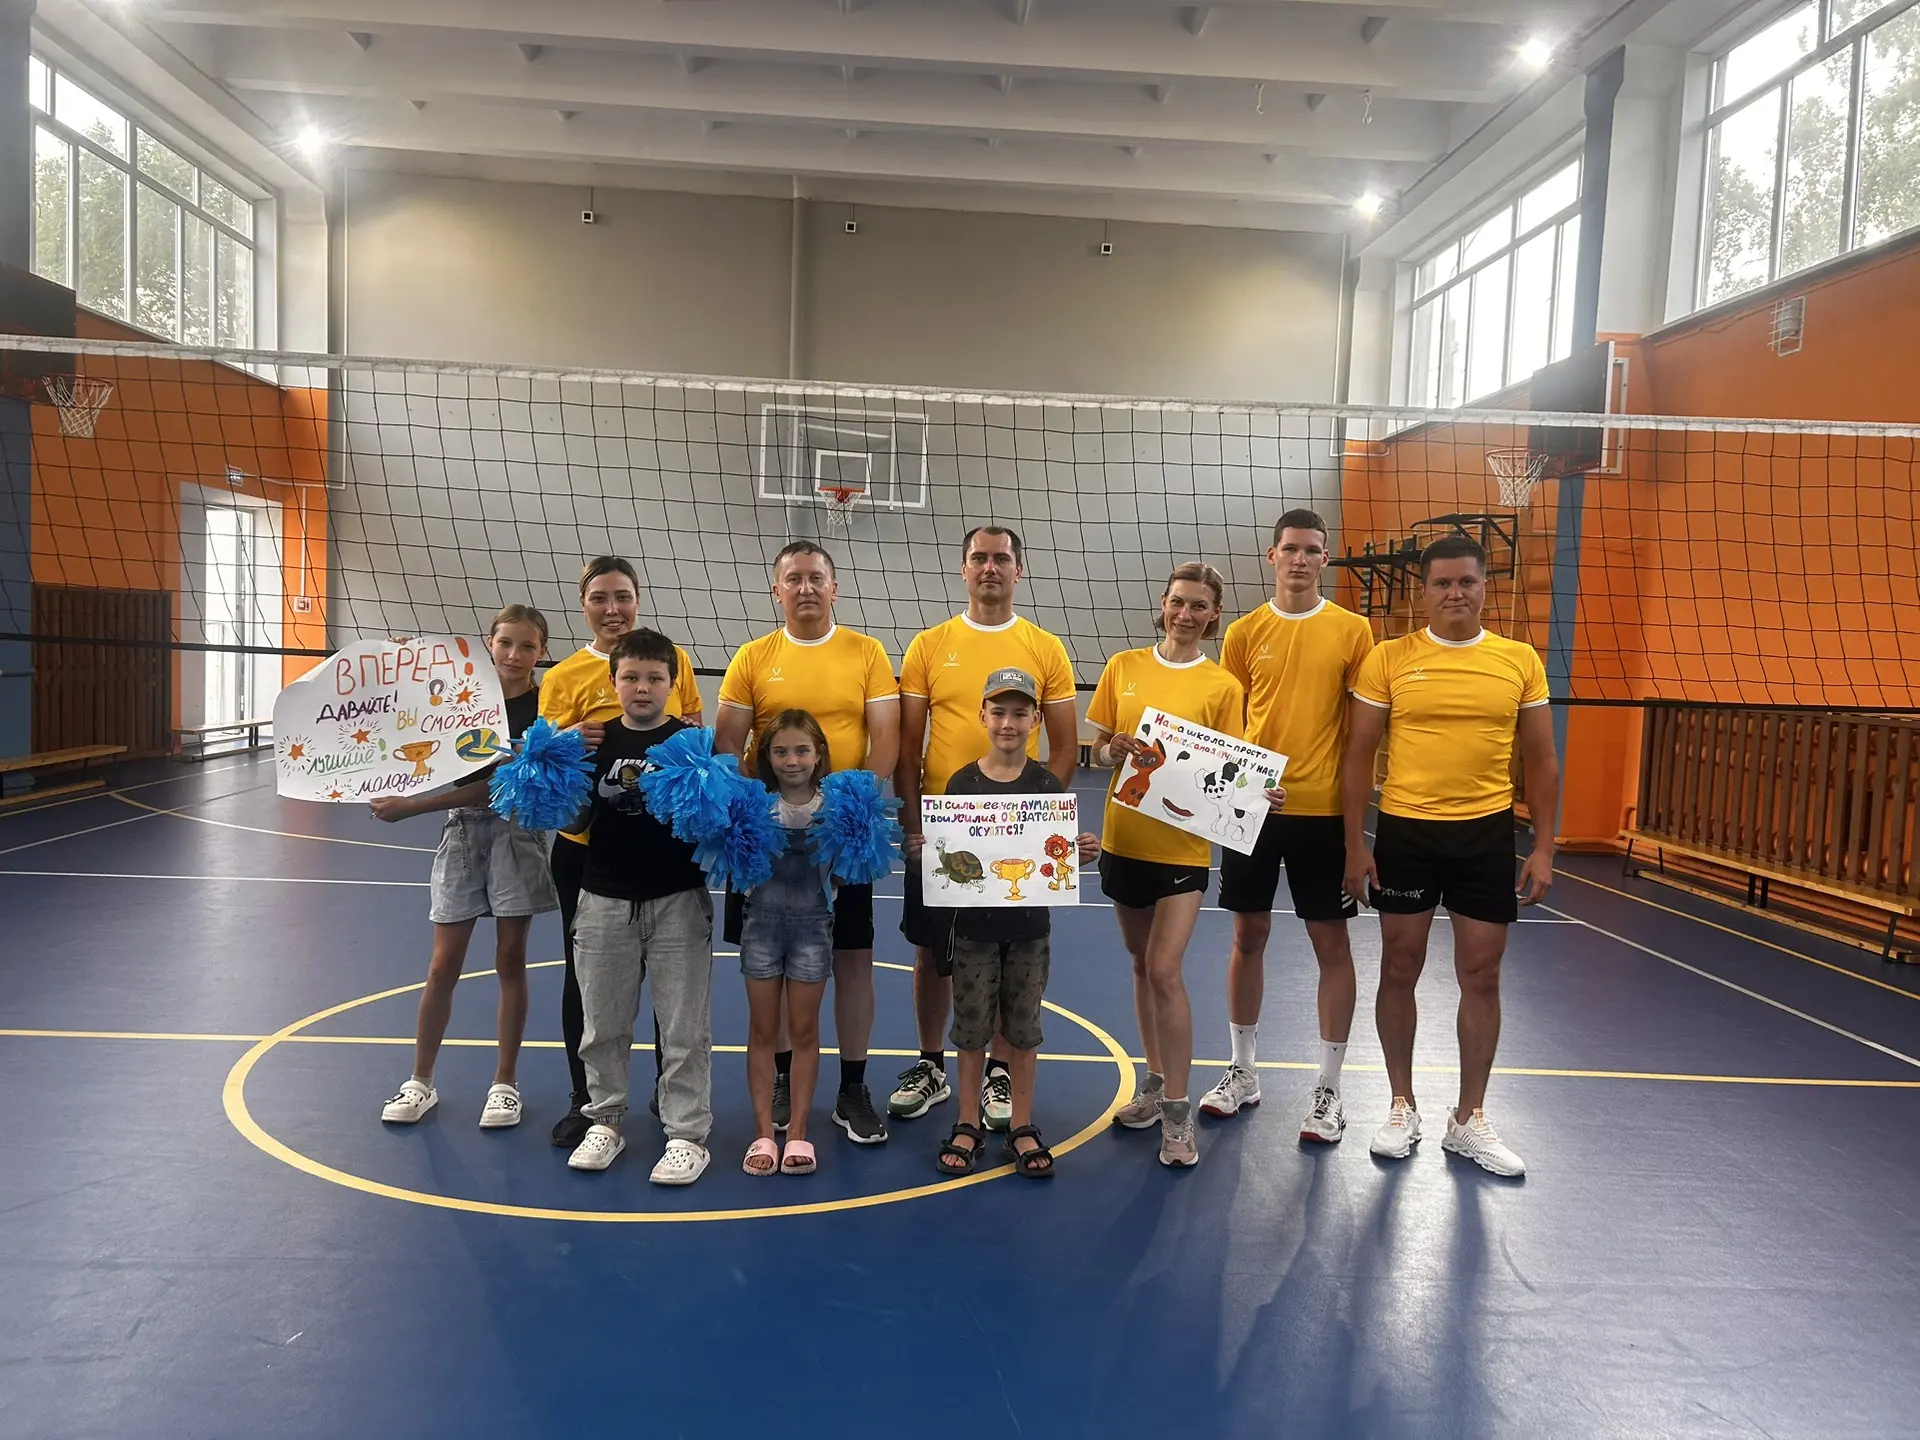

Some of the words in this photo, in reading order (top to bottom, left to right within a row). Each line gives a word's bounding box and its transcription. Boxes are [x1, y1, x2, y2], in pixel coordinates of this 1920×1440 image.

[316, 689, 398, 724] ДАВАЙТЕ!
[1154, 712, 1185, 734] Наша
[1186, 728, 1226, 748] школа
